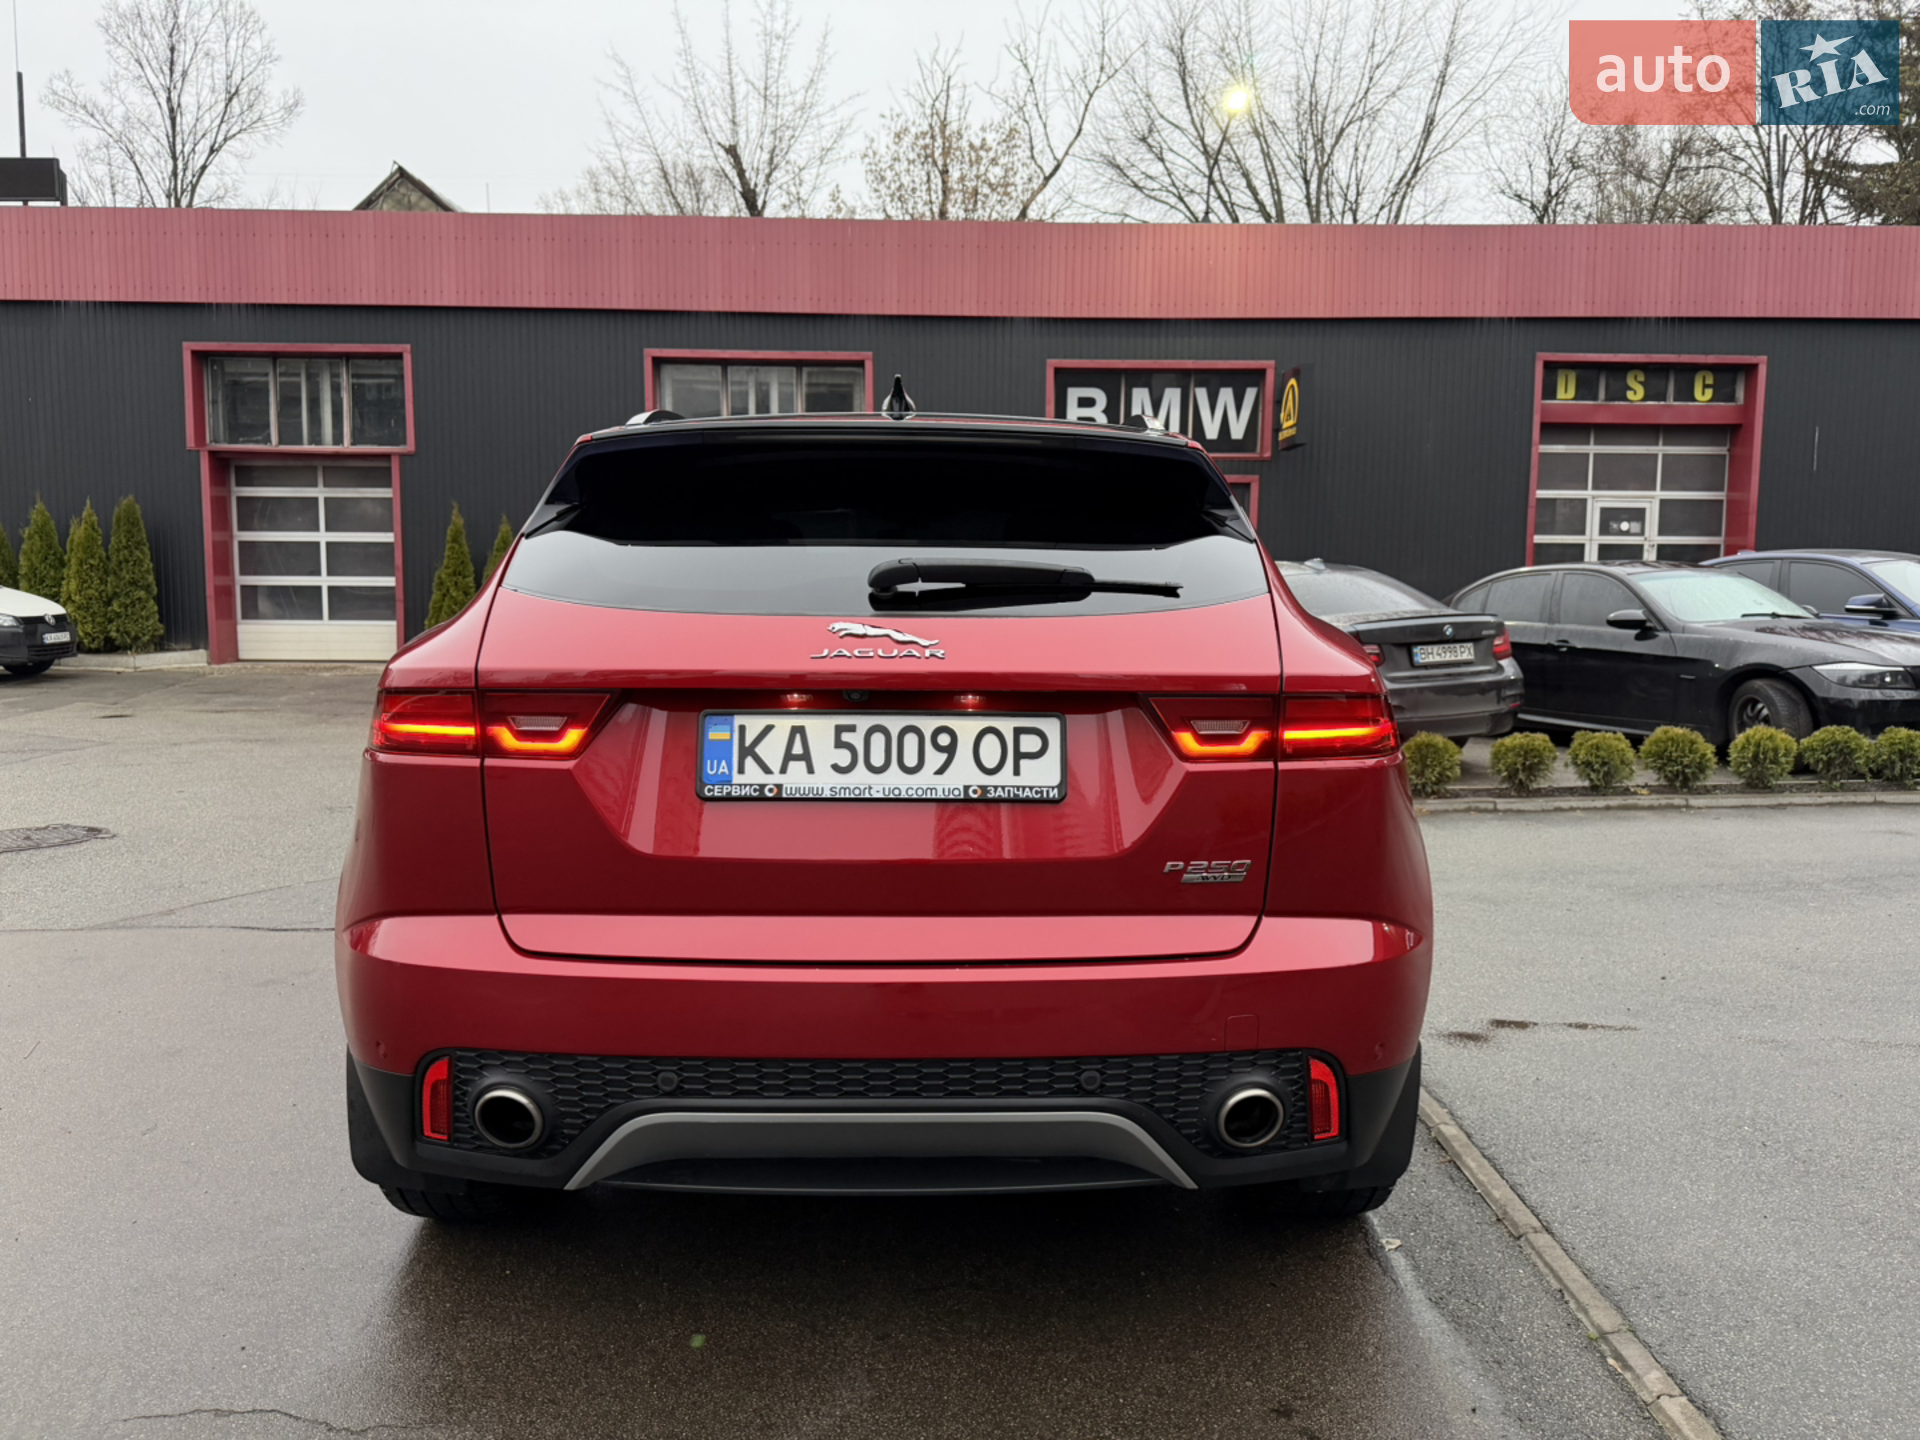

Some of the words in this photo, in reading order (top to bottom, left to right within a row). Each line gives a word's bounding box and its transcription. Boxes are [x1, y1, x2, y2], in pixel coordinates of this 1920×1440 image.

[1065, 386, 1258, 440] BMW
[810, 648, 946, 660] JAGUAR
[737, 724, 816, 775] KA
[830, 724, 959, 776] 5009
[972, 725, 1050, 777] OP
[706, 759, 730, 776] UA
[703, 784, 760, 797] СЕРВИС
[986, 786, 1059, 799] ЗАПЧАСТИ
